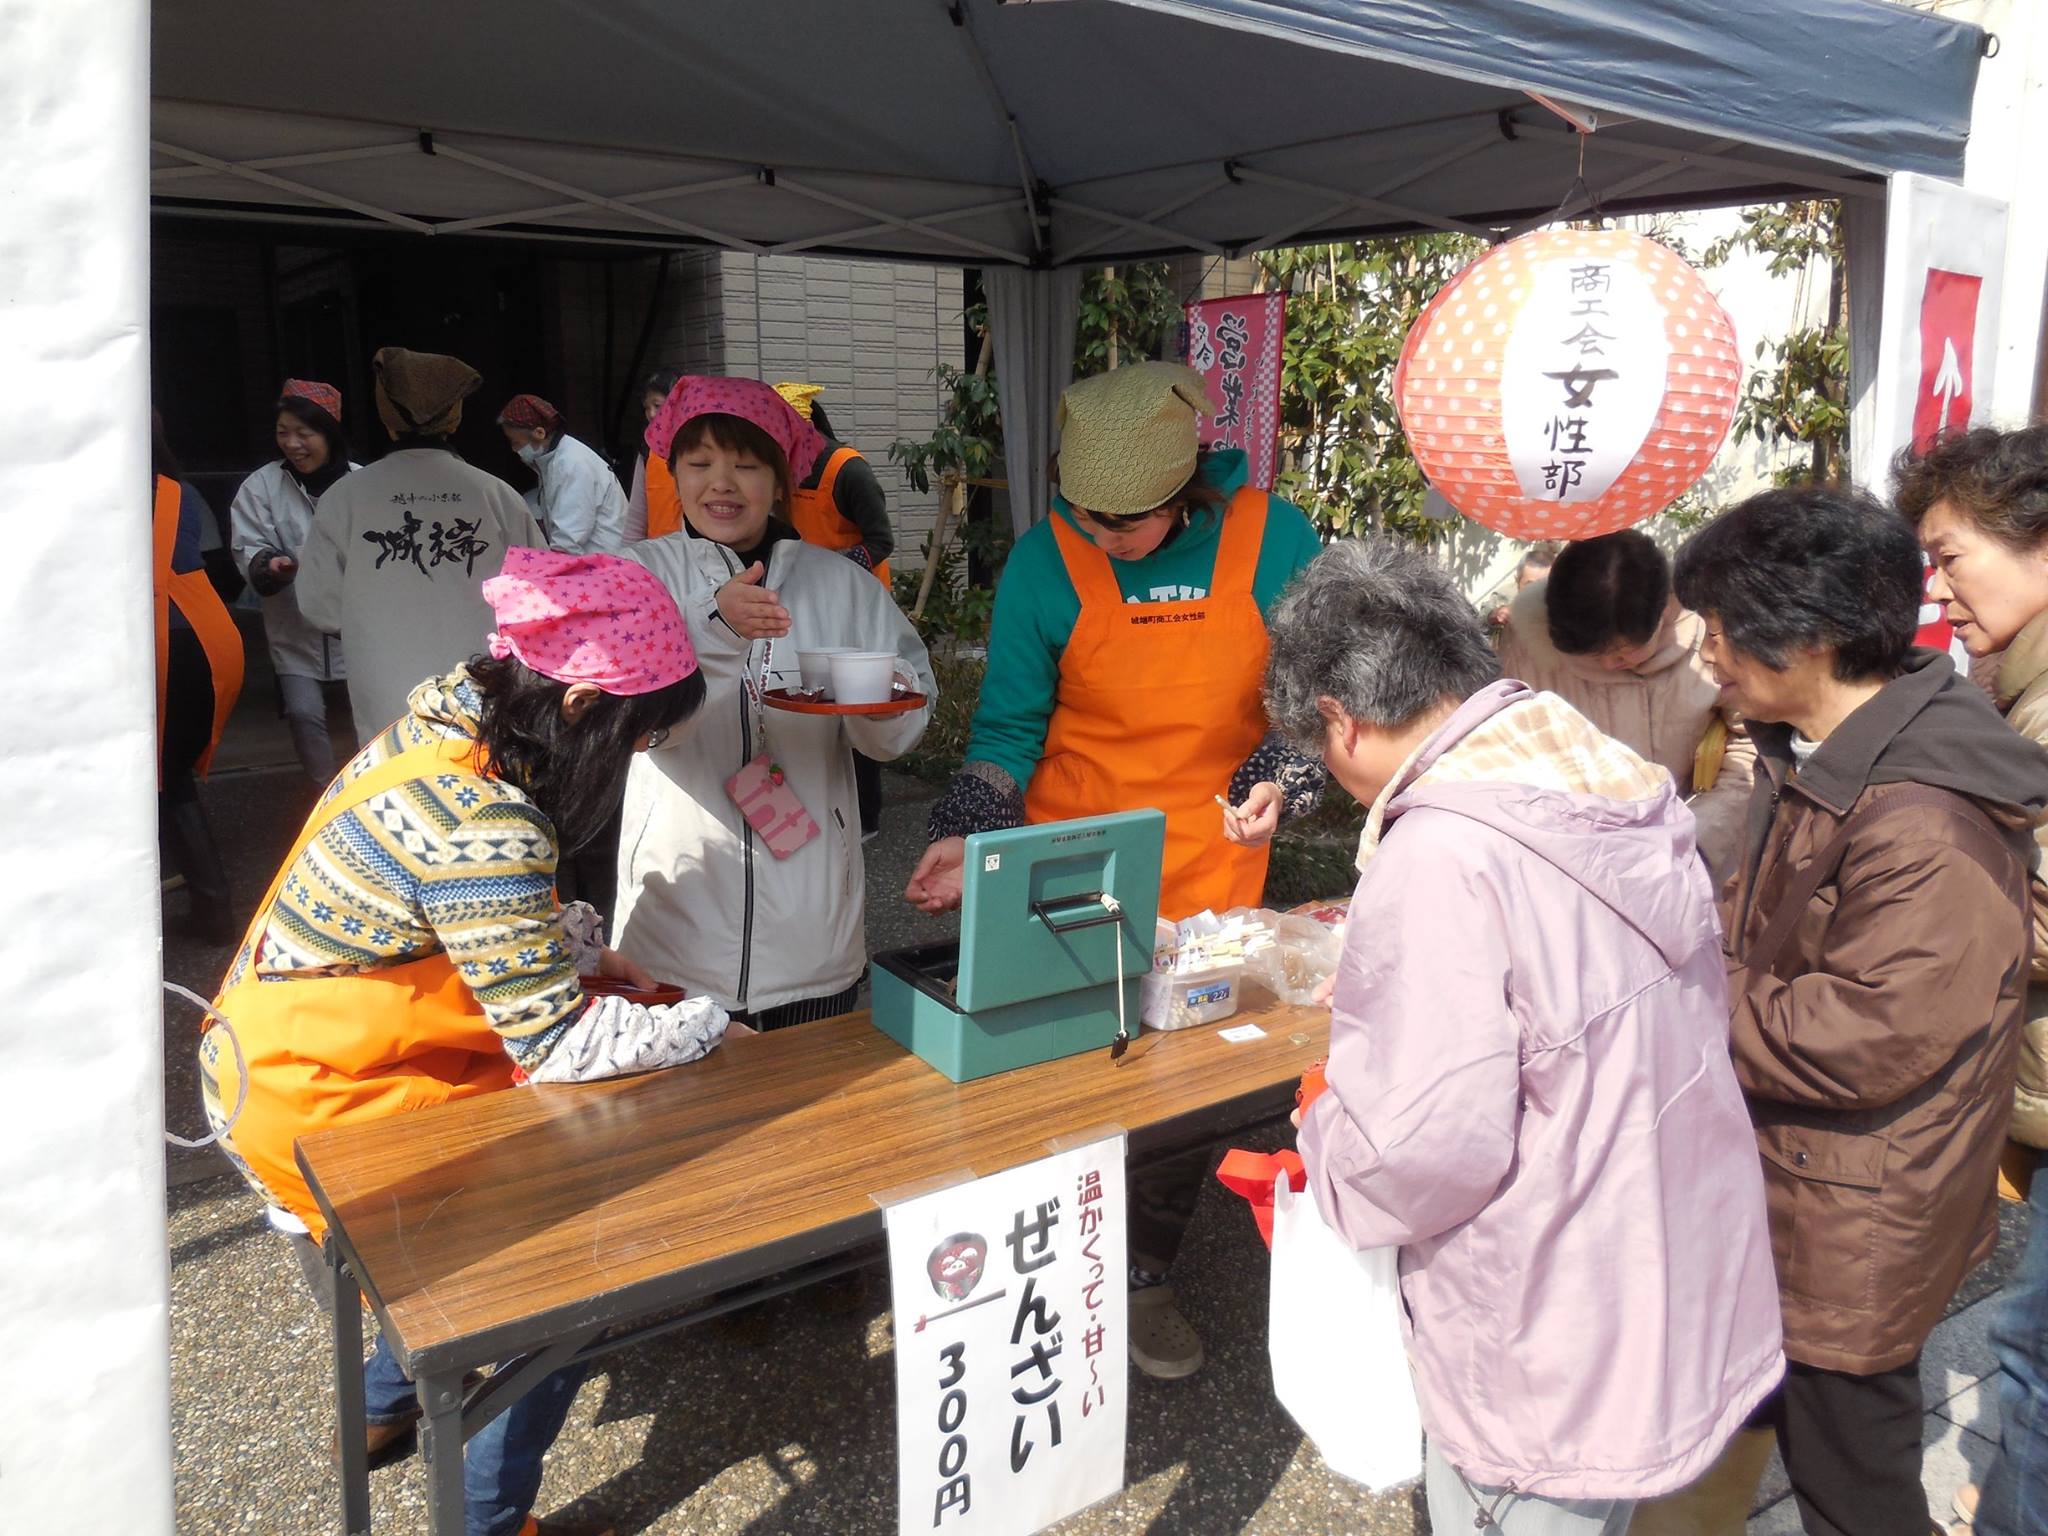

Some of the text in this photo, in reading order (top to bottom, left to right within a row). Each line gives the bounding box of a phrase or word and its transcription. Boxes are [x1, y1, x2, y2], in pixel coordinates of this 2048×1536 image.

[1541, 264, 1619, 498] 商工会女性部
[1131, 611, 1206, 625] 城端町商工会女性部
[933, 1341, 971, 1529] 300円
[1005, 1196, 1063, 1474] ぜんざい
